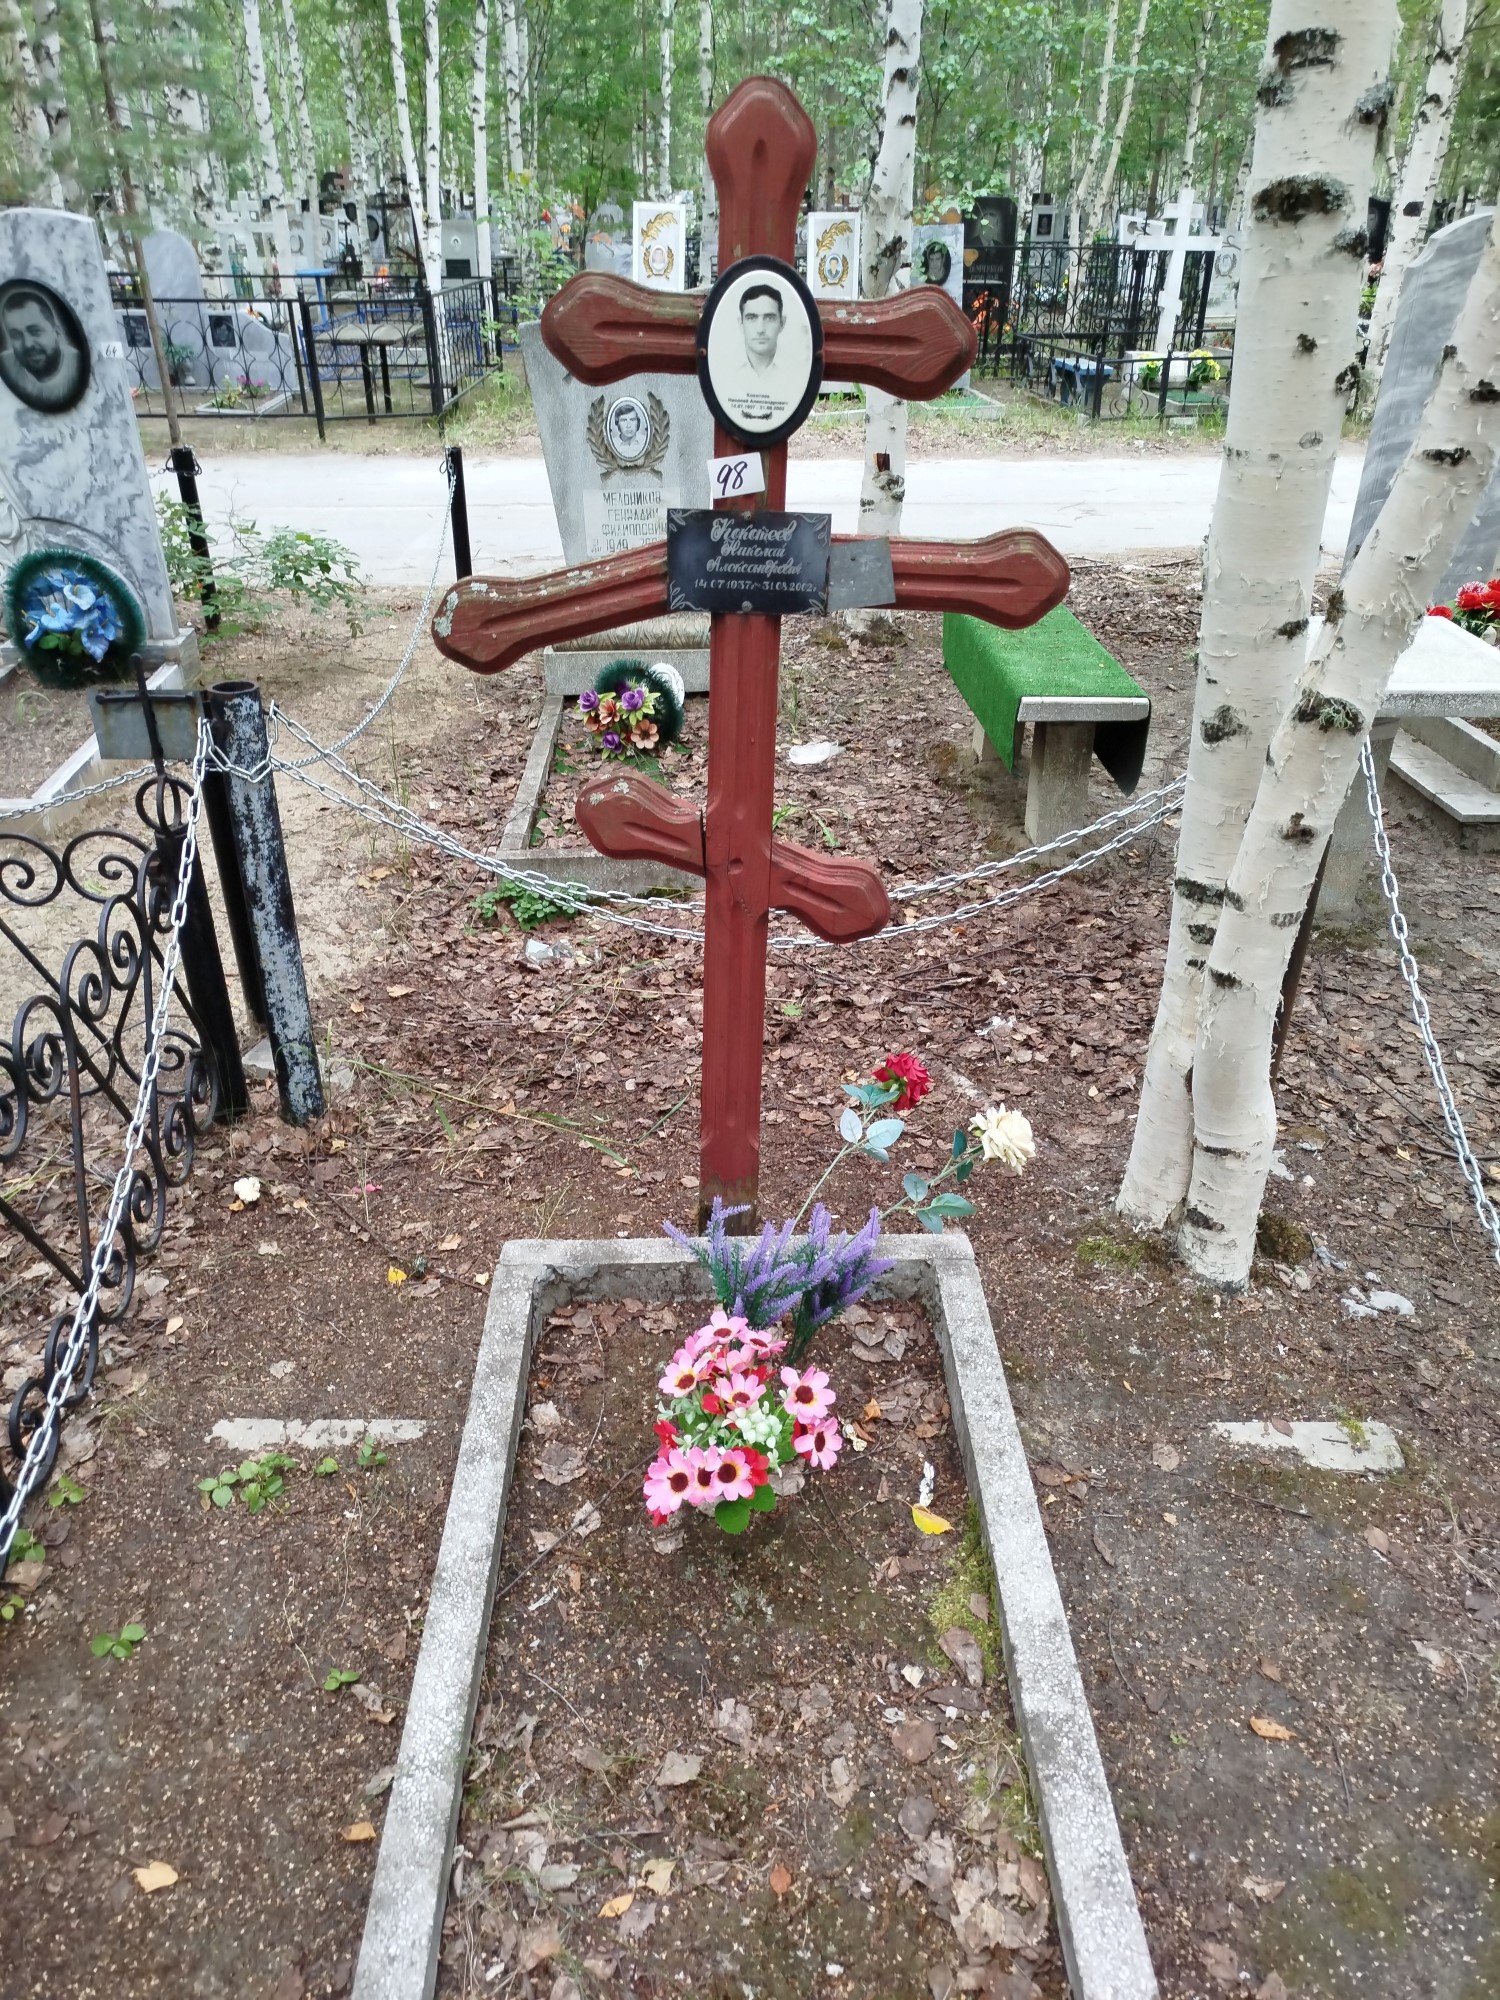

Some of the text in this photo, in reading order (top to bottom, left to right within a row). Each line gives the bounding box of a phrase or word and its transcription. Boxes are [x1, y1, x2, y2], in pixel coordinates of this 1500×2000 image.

[105, 344, 118, 357] 64
[717, 460, 748, 497] 98
[602, 490, 662, 506] МЕЛЬНИКОВ
[721, 540, 787, 558] Николай
[706, 555, 803, 578] Александрович
